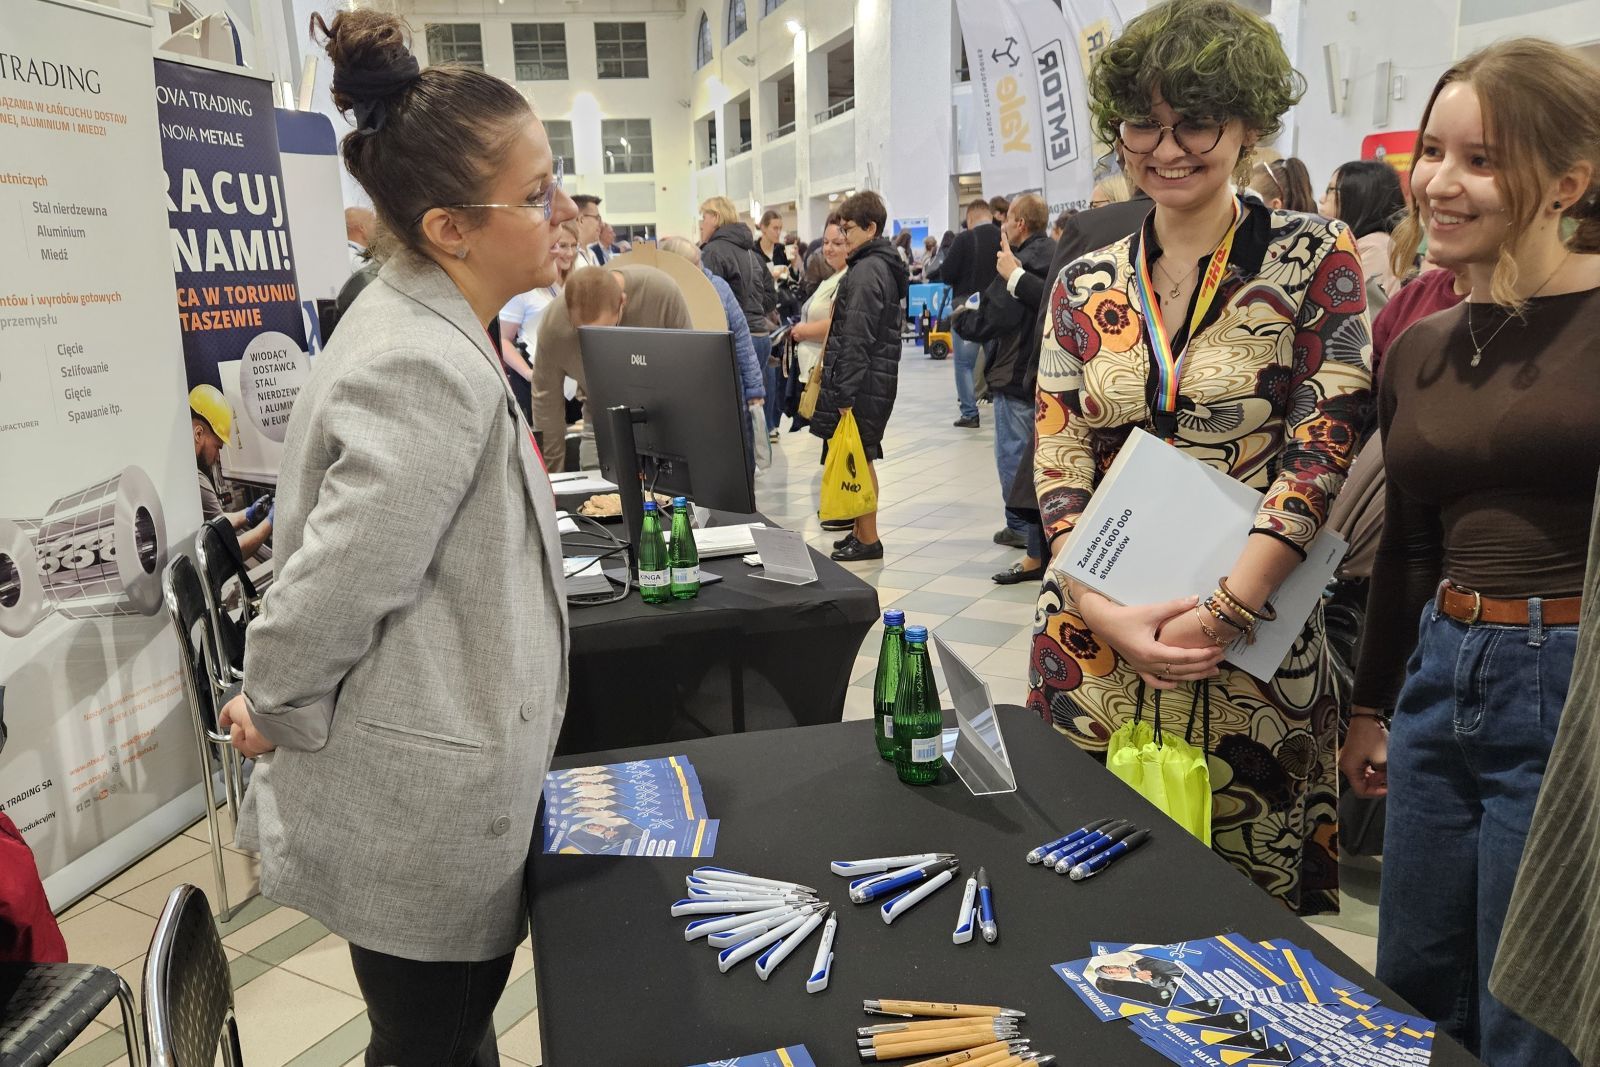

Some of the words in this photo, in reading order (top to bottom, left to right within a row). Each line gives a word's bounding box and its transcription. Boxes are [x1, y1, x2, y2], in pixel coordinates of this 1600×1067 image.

[0, 53, 101, 94] TRADING
[156, 85, 190, 107] OVA
[190, 90, 253, 117] TRADING
[0, 96, 34, 111] ĄZANIA
[35, 101, 45, 113] W
[46, 102, 93, 120] ŁAŃCUCHU
[94, 110, 128, 125] DOSTAW
[0, 112, 19, 128] NEJ,
[20, 115, 70, 132] ALUMINIUM
[77, 123, 107, 137] MIEDZI
[161, 123, 199, 142] NOVA
[199, 128, 245, 148] METALE
[0, 172, 48, 188] utniczych
[163, 168, 284, 228] RACUJ
[32, 200, 52, 214] Stal
[53, 202, 108, 217] nierdzewna
[37, 224, 86, 239] Aluminium
[40, 247, 69, 261] Miedź
[170, 228, 291, 272] NAMI!
[1202, 244, 1228, 293] DHL
[0, 293, 28, 307] ntów
[37, 292, 79, 308] wyrobów
[80, 291, 122, 306] gotowych
[177, 287, 201, 307] CA
[202, 286, 220, 306] W
[224, 284, 296, 305] TORUNIU
[0, 313, 58, 330] przemysłu
[179, 308, 263, 332] TASZEWIE
[57, 342, 84, 356] Cięcie
[250, 349, 288, 361] WIODĄCY
[253, 361, 297, 375] DOSTAWCA
[631, 353, 647, 366] DELL
[60, 360, 109, 378] Szlifowanie
[255, 377, 277, 389] STALI
[64, 385, 92, 401] Gięcie
[257, 386, 300, 402] NIERDZEW
[67, 407, 108, 423] Spawanie
[109, 404, 123, 417] itp.
[265, 400, 294, 414] ALUMIN
[0, 420, 39, 432] UFACTURER
[261, 418, 270, 428] W
[271, 414, 291, 426] EURO
[1077, 534, 1102, 569] Zaufało
[1100, 516, 1115, 536] nam
[1089, 544, 1110, 575] ponad
[1104, 526, 1123, 549] 600
[1116, 508, 1133, 532] 000
[1099, 535, 1130, 580] studentów
[6, 785, 41, 808] TRADING
[42, 779, 53, 790] SA
[18, 811, 56, 834] rodukcyjny
[1078, 983, 1115, 1017] ZATRUDNIMY
